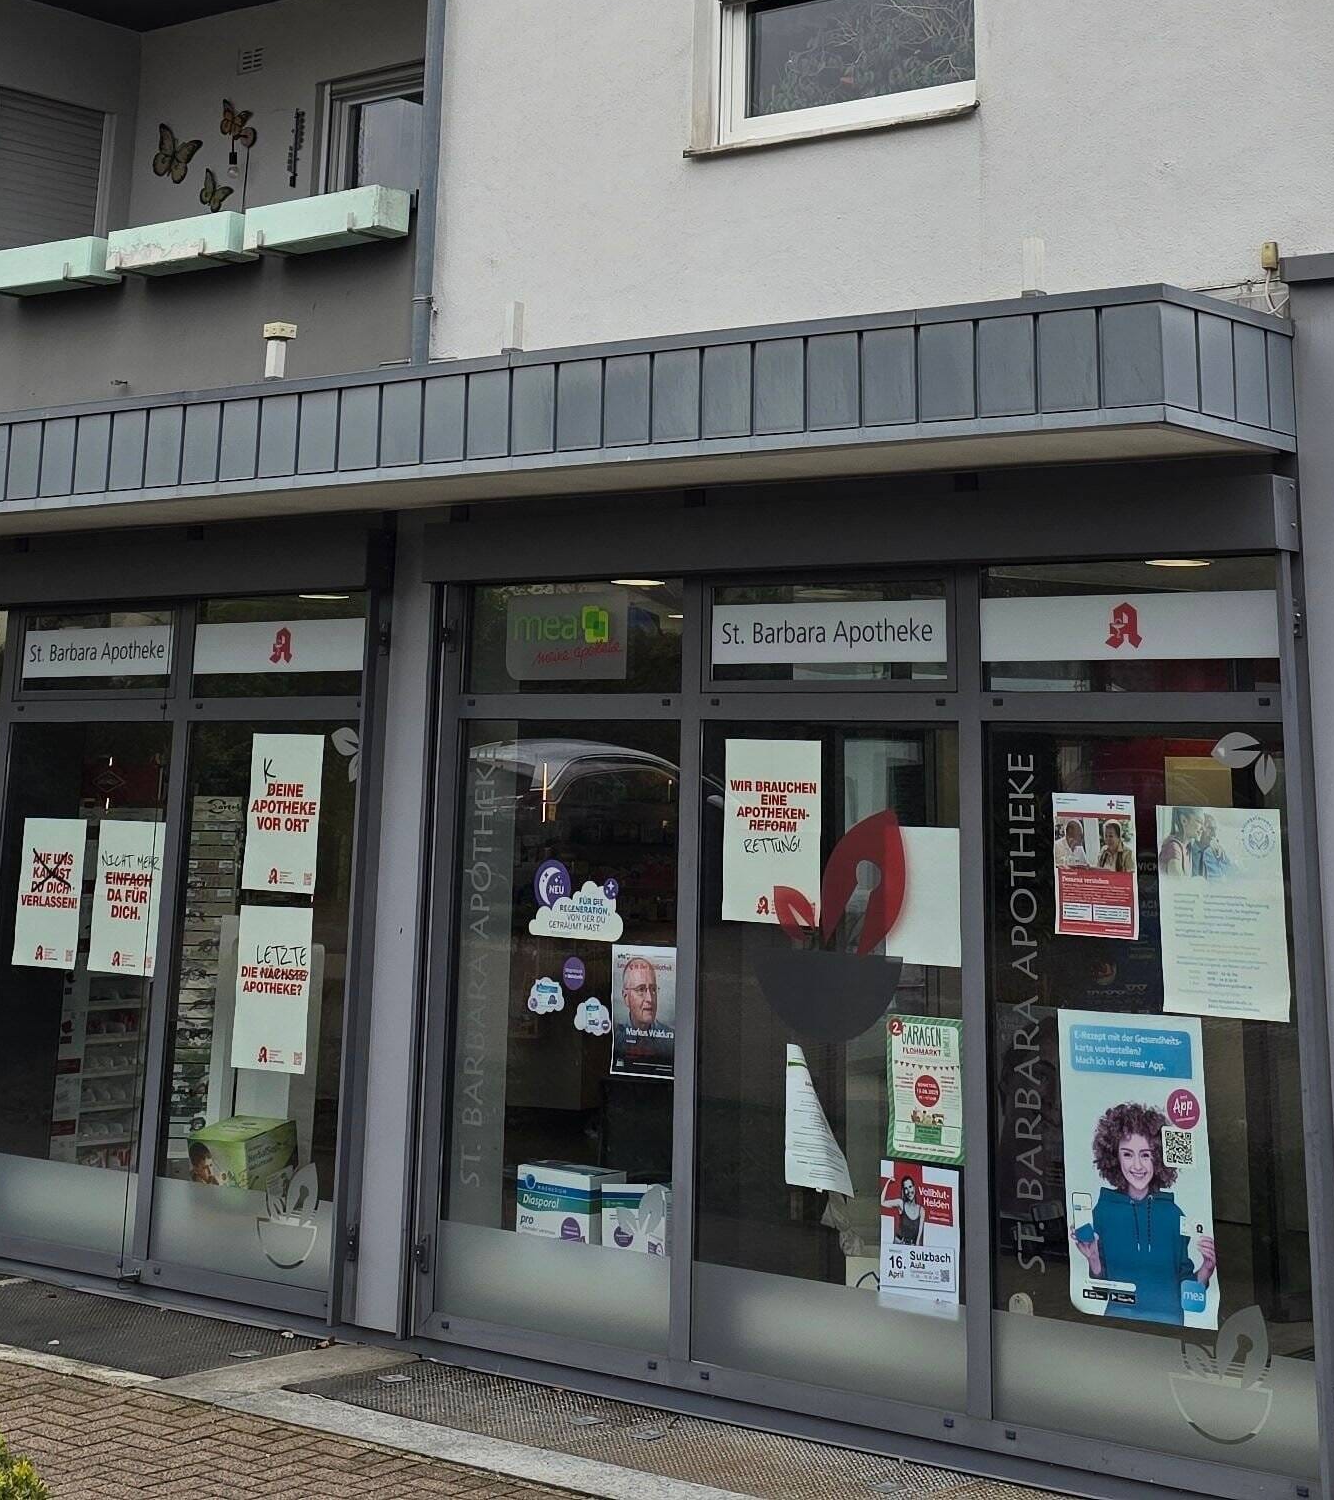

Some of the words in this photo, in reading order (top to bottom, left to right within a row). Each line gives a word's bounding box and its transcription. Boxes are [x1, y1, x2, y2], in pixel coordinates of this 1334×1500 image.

[514, 613, 578, 642] mea
[722, 622, 744, 645] St.
[753, 620, 826, 644] Barbara
[833, 617, 933, 648] Apotheke
[29, 644, 45, 663] St.
[49, 641, 98, 662] Barbara
[100, 638, 165, 666] Apotheke
[267, 783, 304, 797] DEINE
[730, 779, 752, 792] WIR
[755, 781, 817, 794] BRAUCHEN
[251, 800, 317, 815] APOTHEKE
[761, 794, 787, 806] EINE
[737, 807, 810, 820] APOTHEKEN-
[256, 817, 281, 831] VOR
[284, 818, 309, 832] ORT
[749, 819, 797, 833] REFORM
[743, 835, 802, 854] RETTUNG!
[102, 850, 134, 869] NICHT
[137, 853, 161, 871] MEHR
[1007, 752, 1039, 981] APOTHEKE
[105, 871, 153, 887] EINFACH
[107, 888, 122, 902] DA
[125, 886, 147, 904] FÜR
[549, 884, 564, 896] NEU
[21, 894, 78, 909] VERLASSEN!
[111, 905, 141, 920] DICH.
[256, 944, 308, 967] LETZTE
[241, 966, 258, 978] DIE
[243, 981, 303, 996] APOTHEKE?
[892, 1021, 902, 1034] 2
[460, 952, 489, 1128] BARBARA
[902, 1024, 942, 1047] GARAGEN
[1074, 1030, 1106, 1043] E-Rezept
[1107, 1033, 1120, 1042] mit
[1121, 1034, 1133, 1043] der
[1134, 1034, 1183, 1046] Gesundheits-
[902, 1047, 942, 1057] FLOHMARKT
[1075, 1055, 1095, 1065] Mach
[1095, 1057, 1107, 1066] ich
[1115, 1058, 1128, 1067] der
[1148, 1060, 1167, 1072] App.
[1013, 993, 1044, 1202] BARBARA
[1172, 1097, 1193, 1117] App
[459, 1141, 482, 1188] ST.
[522, 1193, 560, 1210] Diasporal
[520, 1214, 534, 1225] pro
[1017, 1220, 1045, 1274] ST.
[889, 1255, 906, 1270] 16.
[909, 1250, 951, 1264] Sulzbach
[909, 1261, 926, 1270] Aula
[888, 1269, 904, 1279] April
[1182, 1290, 1205, 1301] mea
